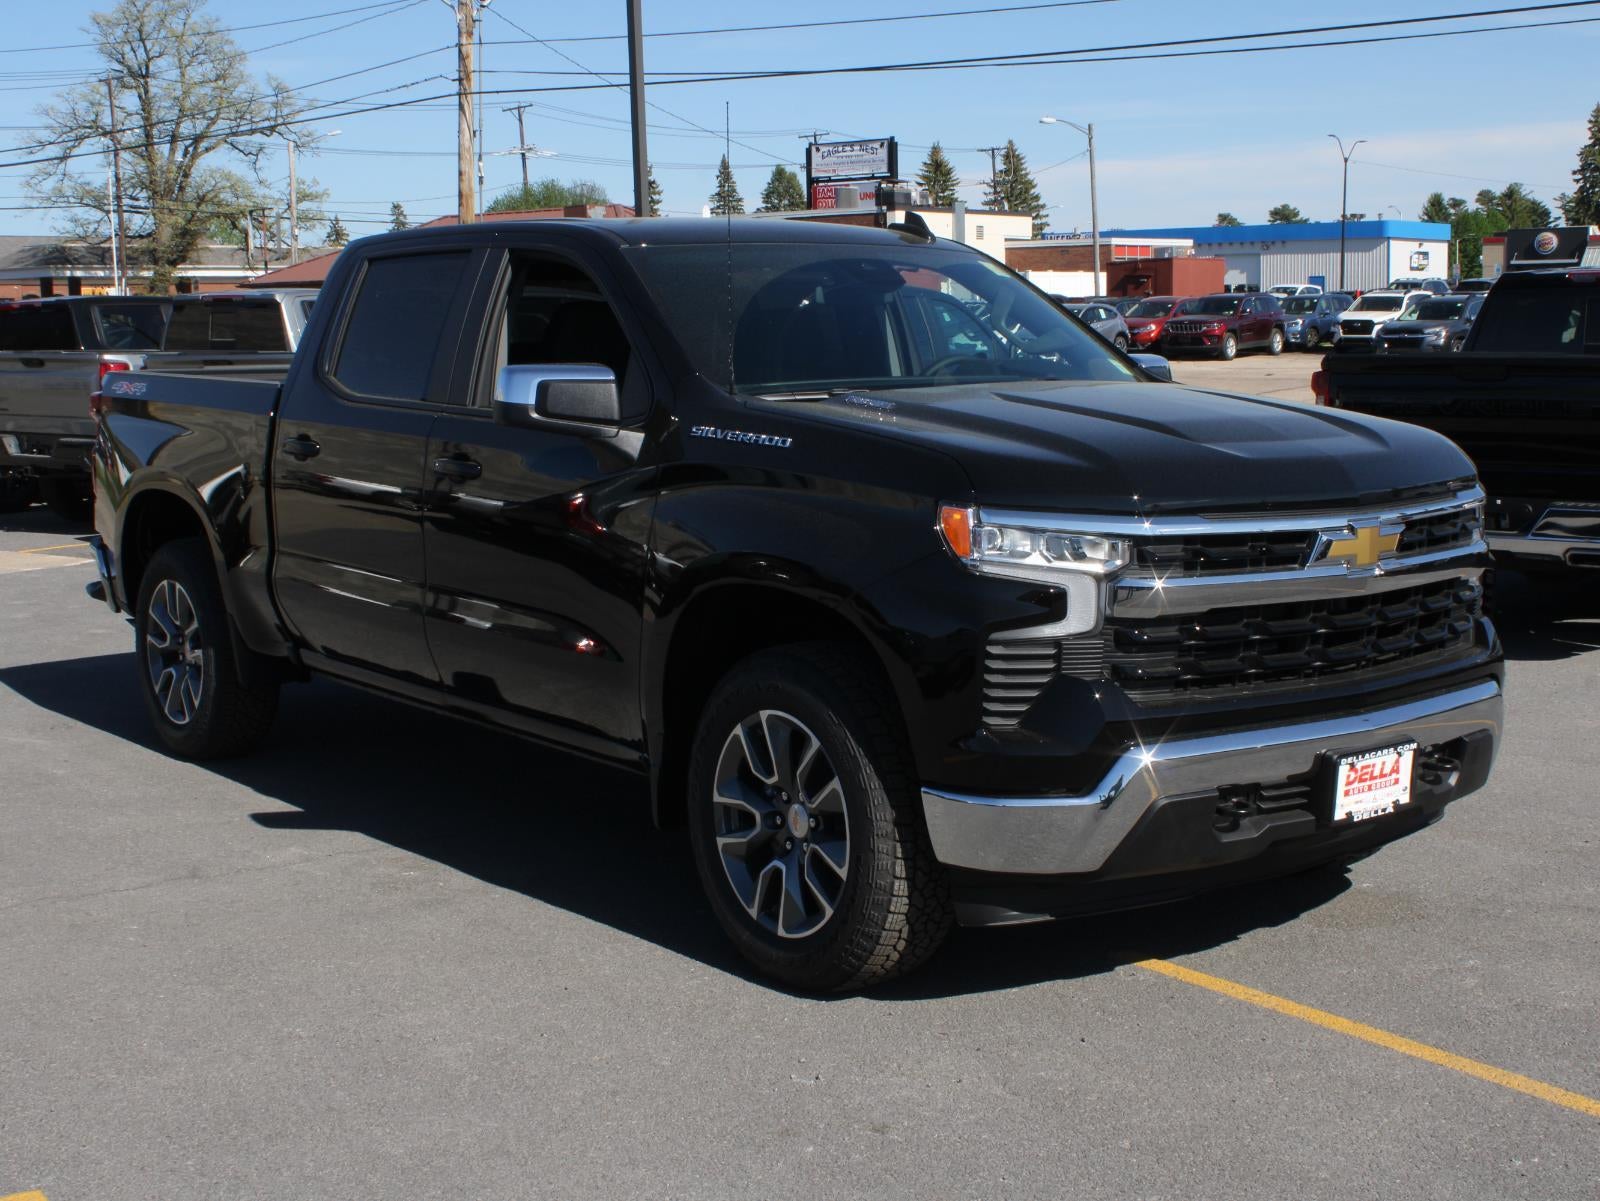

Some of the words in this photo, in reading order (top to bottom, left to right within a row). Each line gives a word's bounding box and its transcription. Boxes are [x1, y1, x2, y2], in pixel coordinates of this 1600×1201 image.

[821, 144, 854, 160] EAGLE'S
[859, 143, 878, 156] NEST
[690, 425, 793, 448] SILVERADO
[1341, 742, 1418, 765] DELLACARS.COM
[1345, 757, 1400, 787] DELLA
[1348, 786, 1369, 797] AUTO
[1372, 778, 1395, 793] GROUP
[1353, 806, 1395, 822] DELLA
